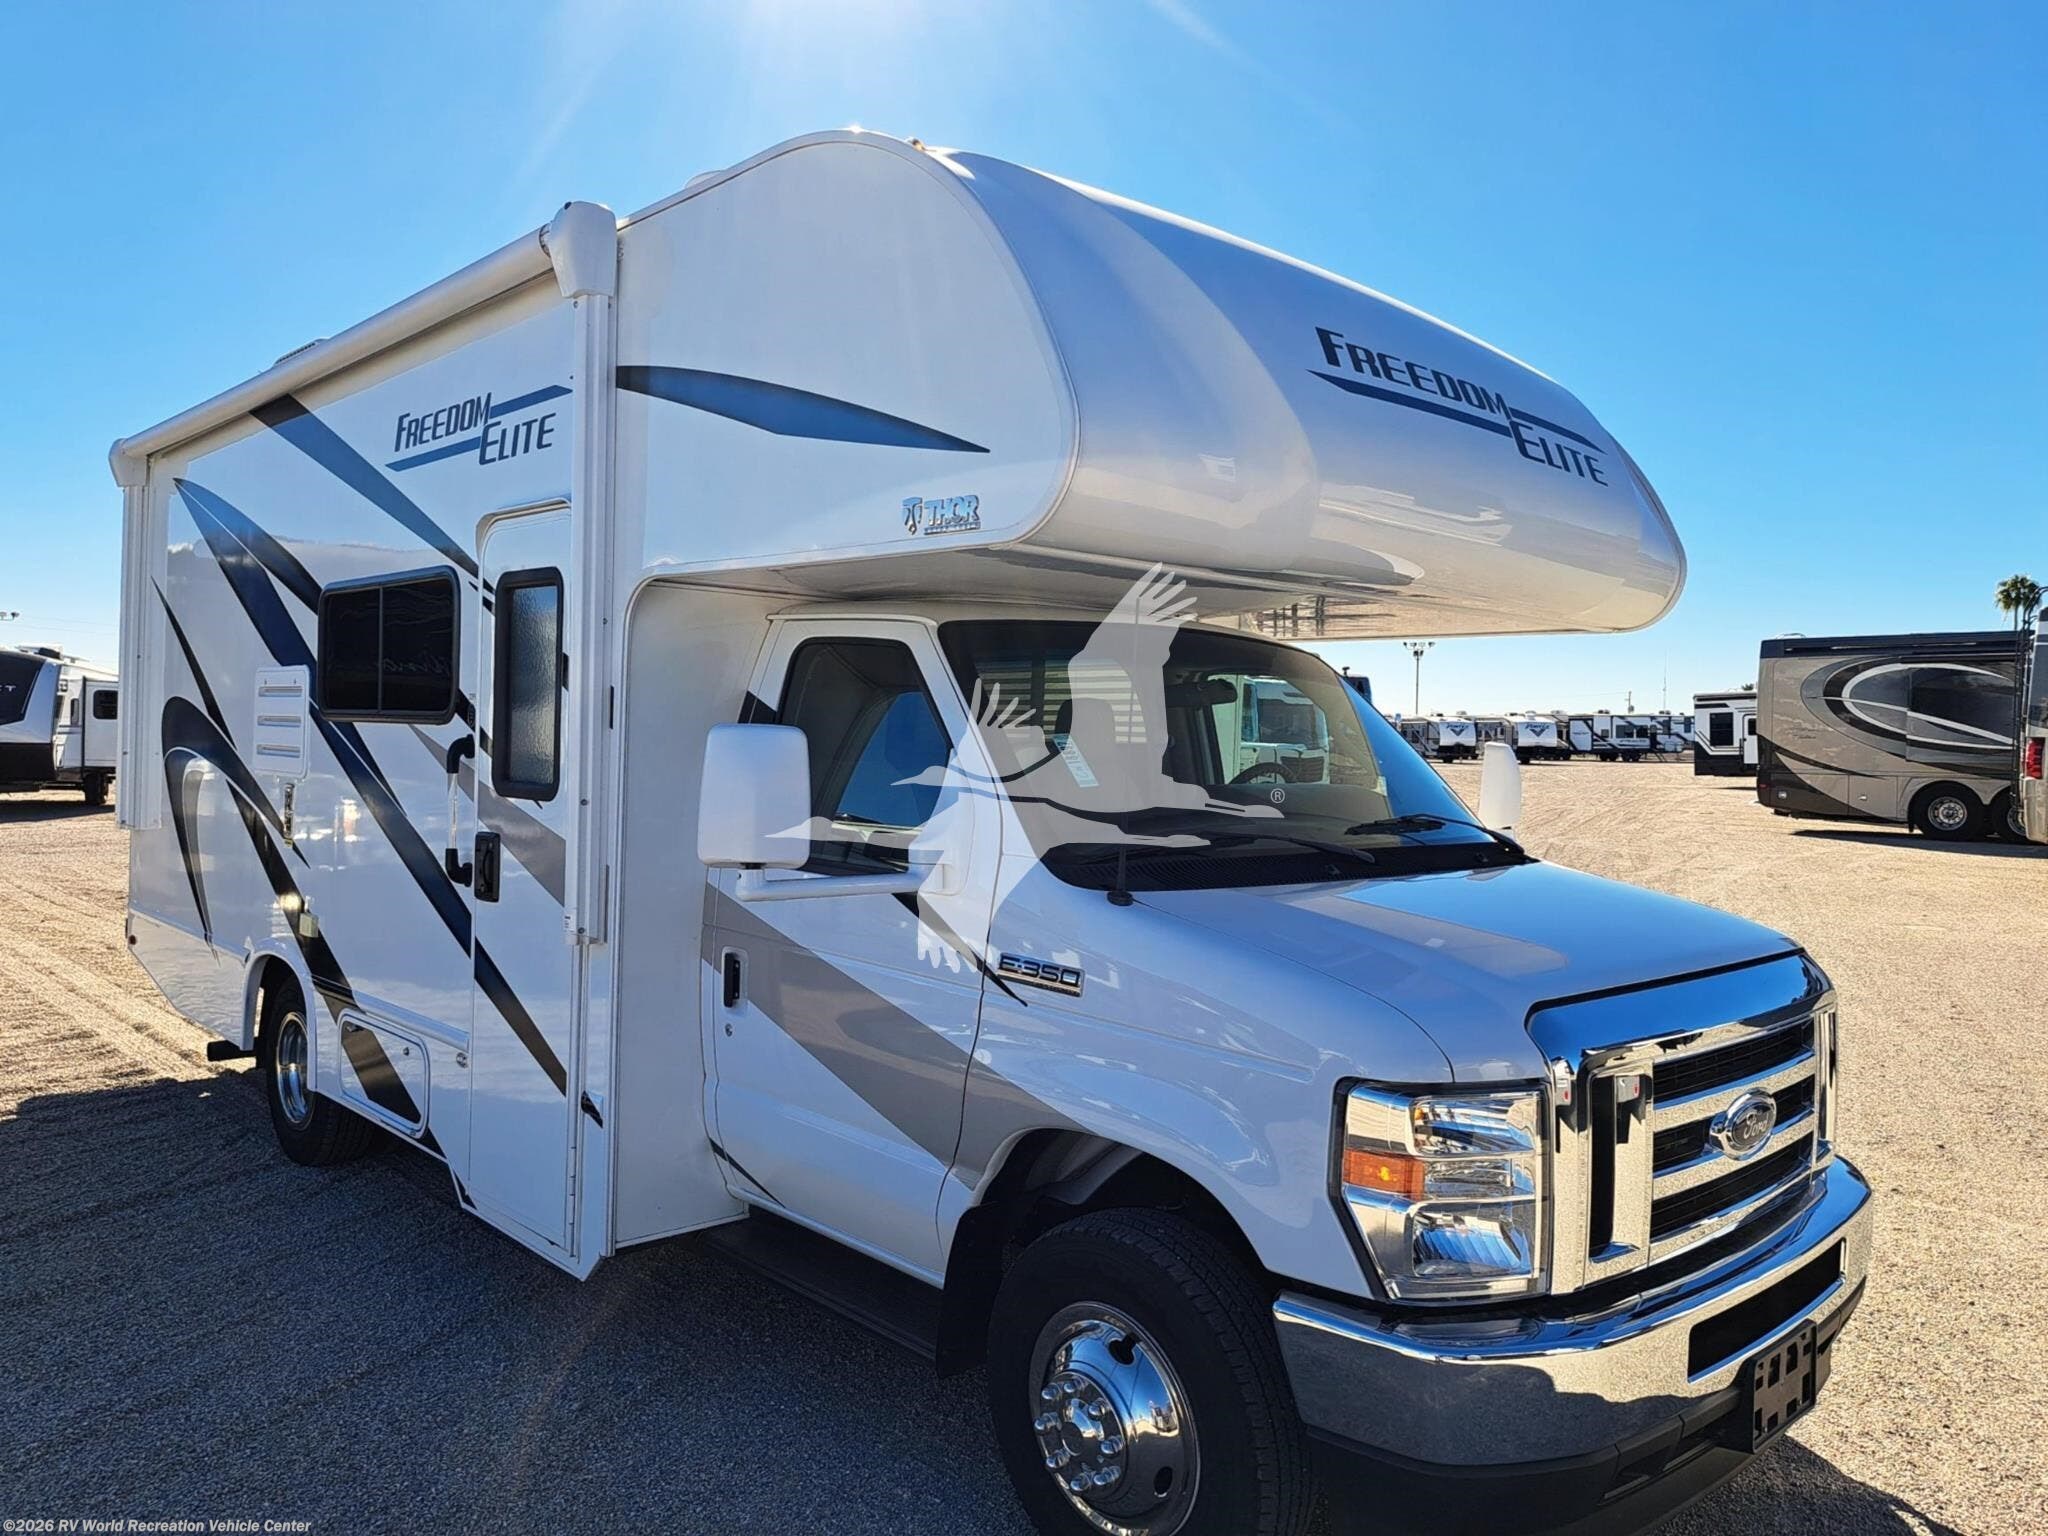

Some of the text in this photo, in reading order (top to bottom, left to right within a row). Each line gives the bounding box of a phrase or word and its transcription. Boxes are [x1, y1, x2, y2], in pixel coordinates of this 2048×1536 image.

[1314, 326, 1511, 421] FREEDOM
[394, 392, 492, 453] FREEDOM
[478, 412, 557, 466] ELITE
[1510, 419, 1609, 488] ELITE
[924, 494, 981, 527] THOR
[998, 954, 1081, 988] E-350
[1743, 1111, 1770, 1139] Ford
